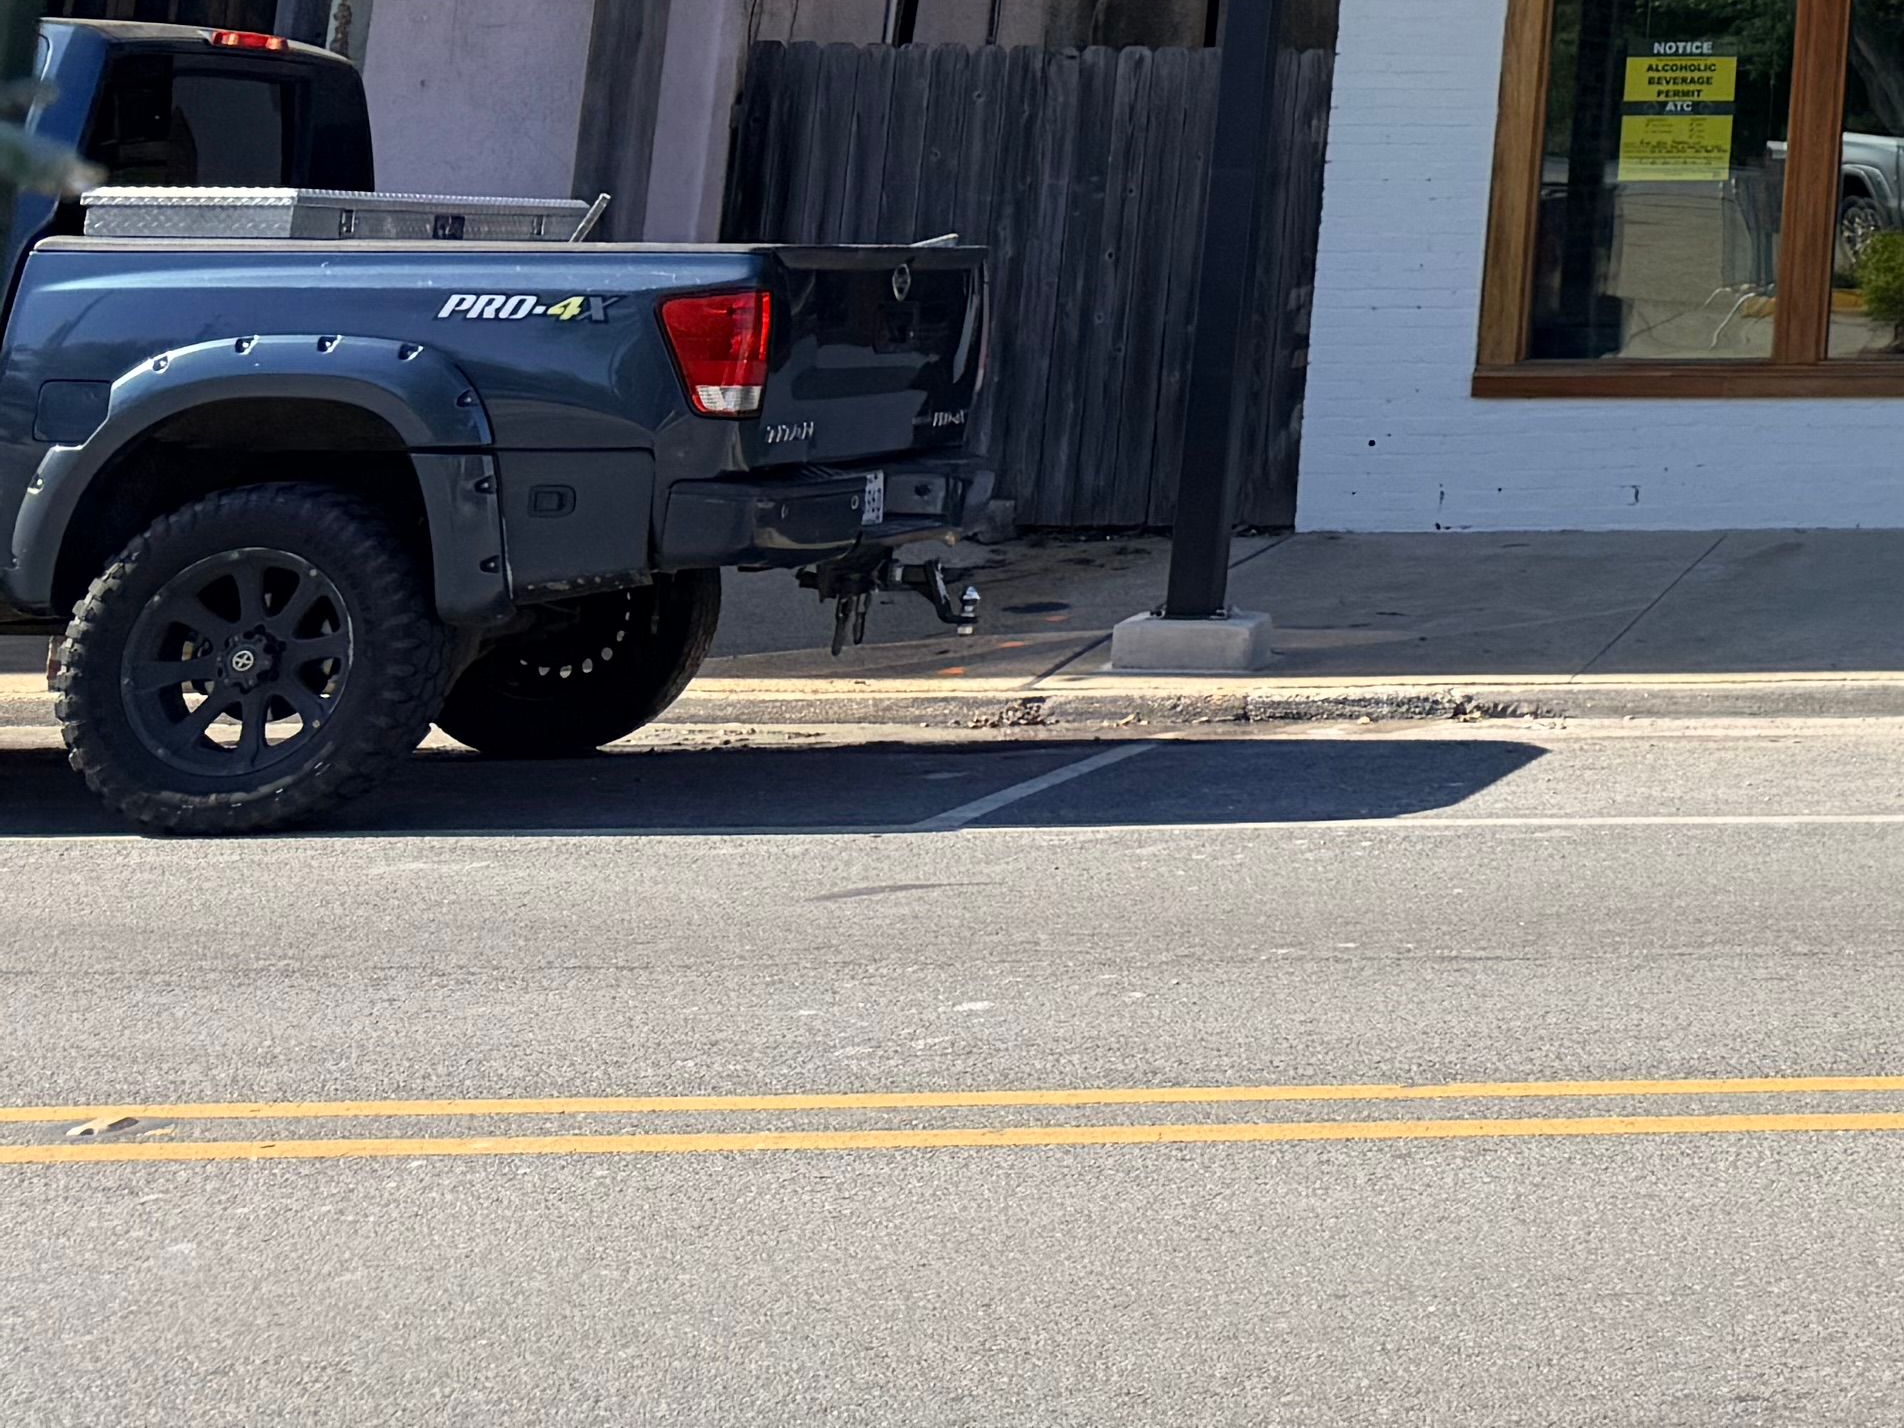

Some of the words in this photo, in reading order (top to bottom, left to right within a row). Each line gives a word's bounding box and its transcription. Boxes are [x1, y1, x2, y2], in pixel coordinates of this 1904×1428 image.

[1653, 42, 1713, 54] NOTICE
[1646, 63, 1717, 72] ALCOHOLIC
[1648, 76, 1713, 85] BEVERAGE
[1656, 89, 1703, 98] PERMIT
[1665, 101, 1693, 112] ATC
[437, 293, 619, 322] PRO-4X
